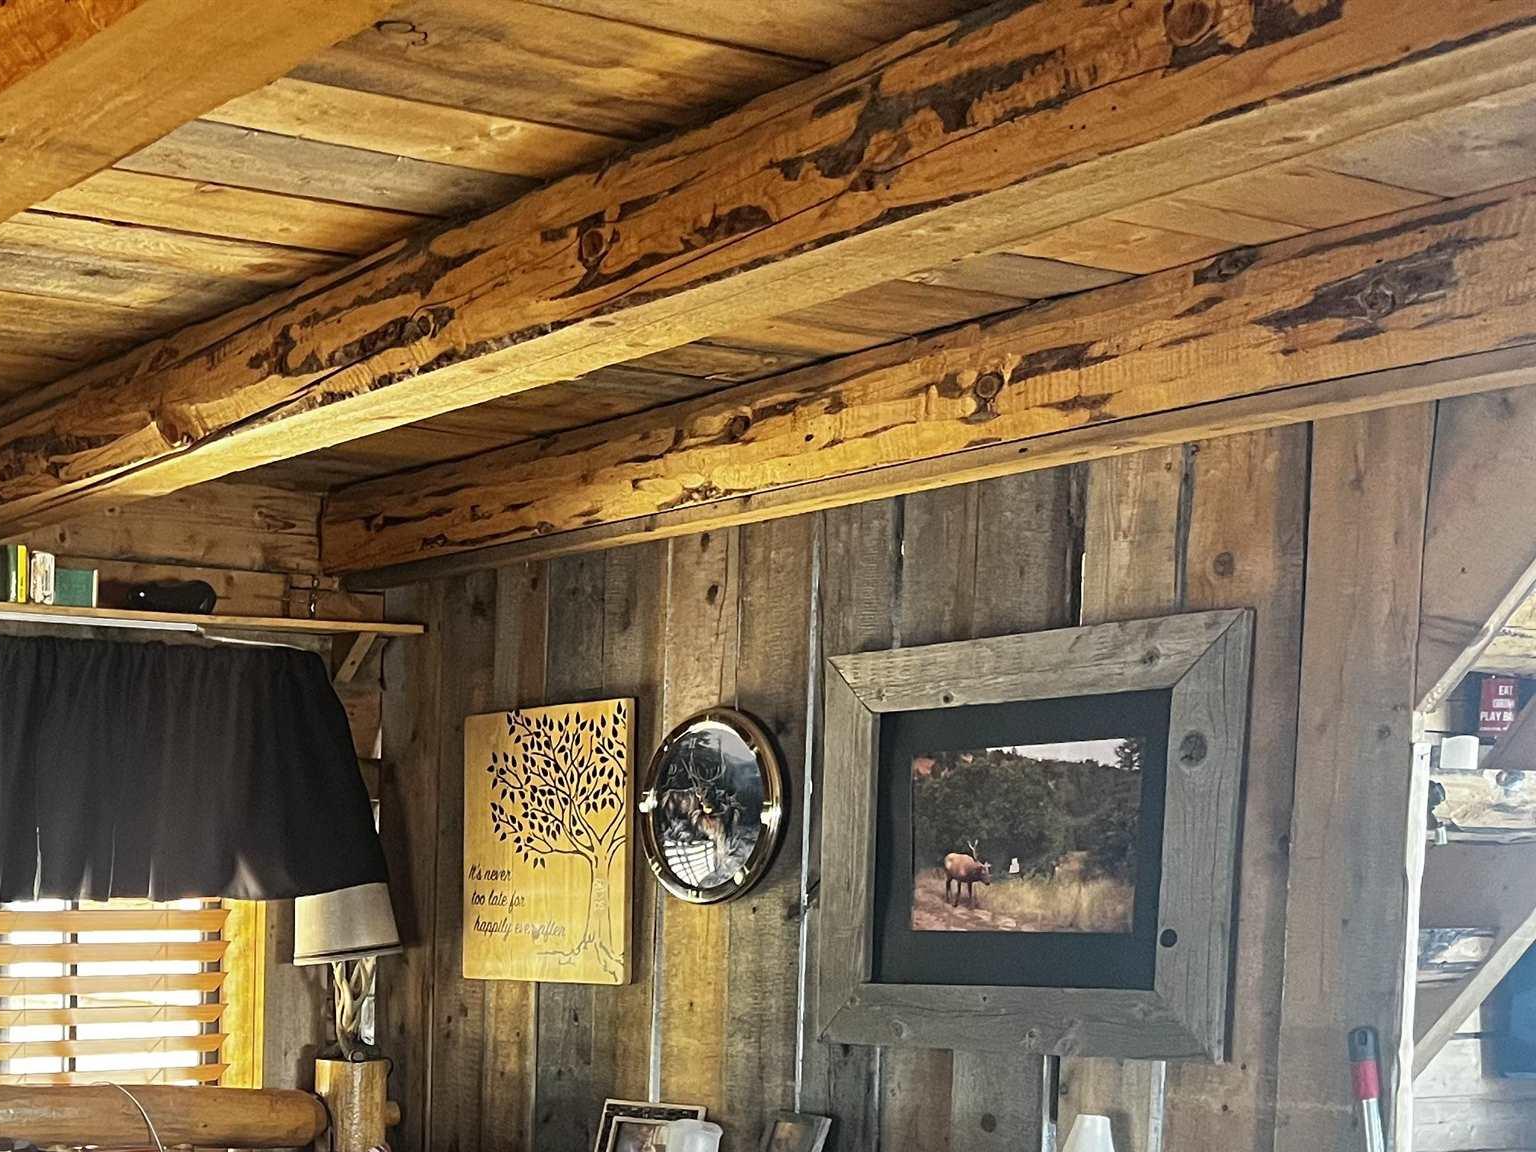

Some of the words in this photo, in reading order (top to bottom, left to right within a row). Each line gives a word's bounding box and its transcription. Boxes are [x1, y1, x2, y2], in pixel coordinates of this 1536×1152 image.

[1480, 711, 1502, 721] PLAY
[468, 863, 482, 881] It's
[484, 868, 511, 881] never
[471, 890, 485, 906] too
[488, 889, 508, 907] late
[508, 890, 525, 914] for
[473, 915, 512, 942] happily
